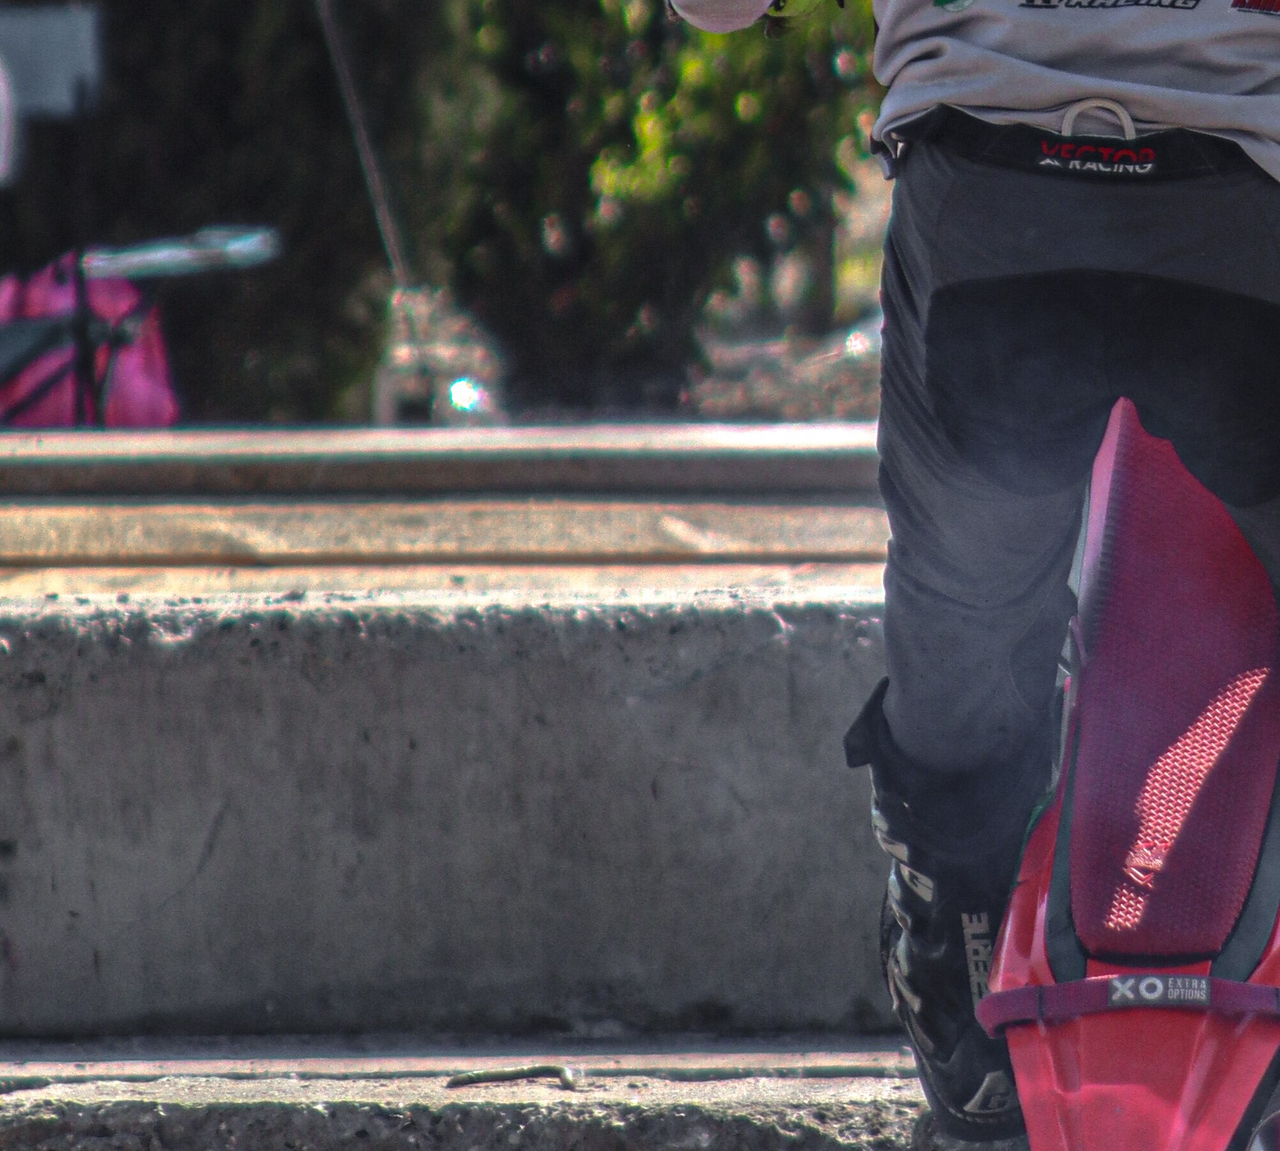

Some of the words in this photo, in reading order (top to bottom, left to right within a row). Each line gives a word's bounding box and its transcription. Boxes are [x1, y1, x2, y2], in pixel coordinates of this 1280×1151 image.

[1112, 977, 1163, 1000] XO
[1168, 977, 1206, 988] EXTRA
[1168, 988, 1206, 999] OPTIONS
